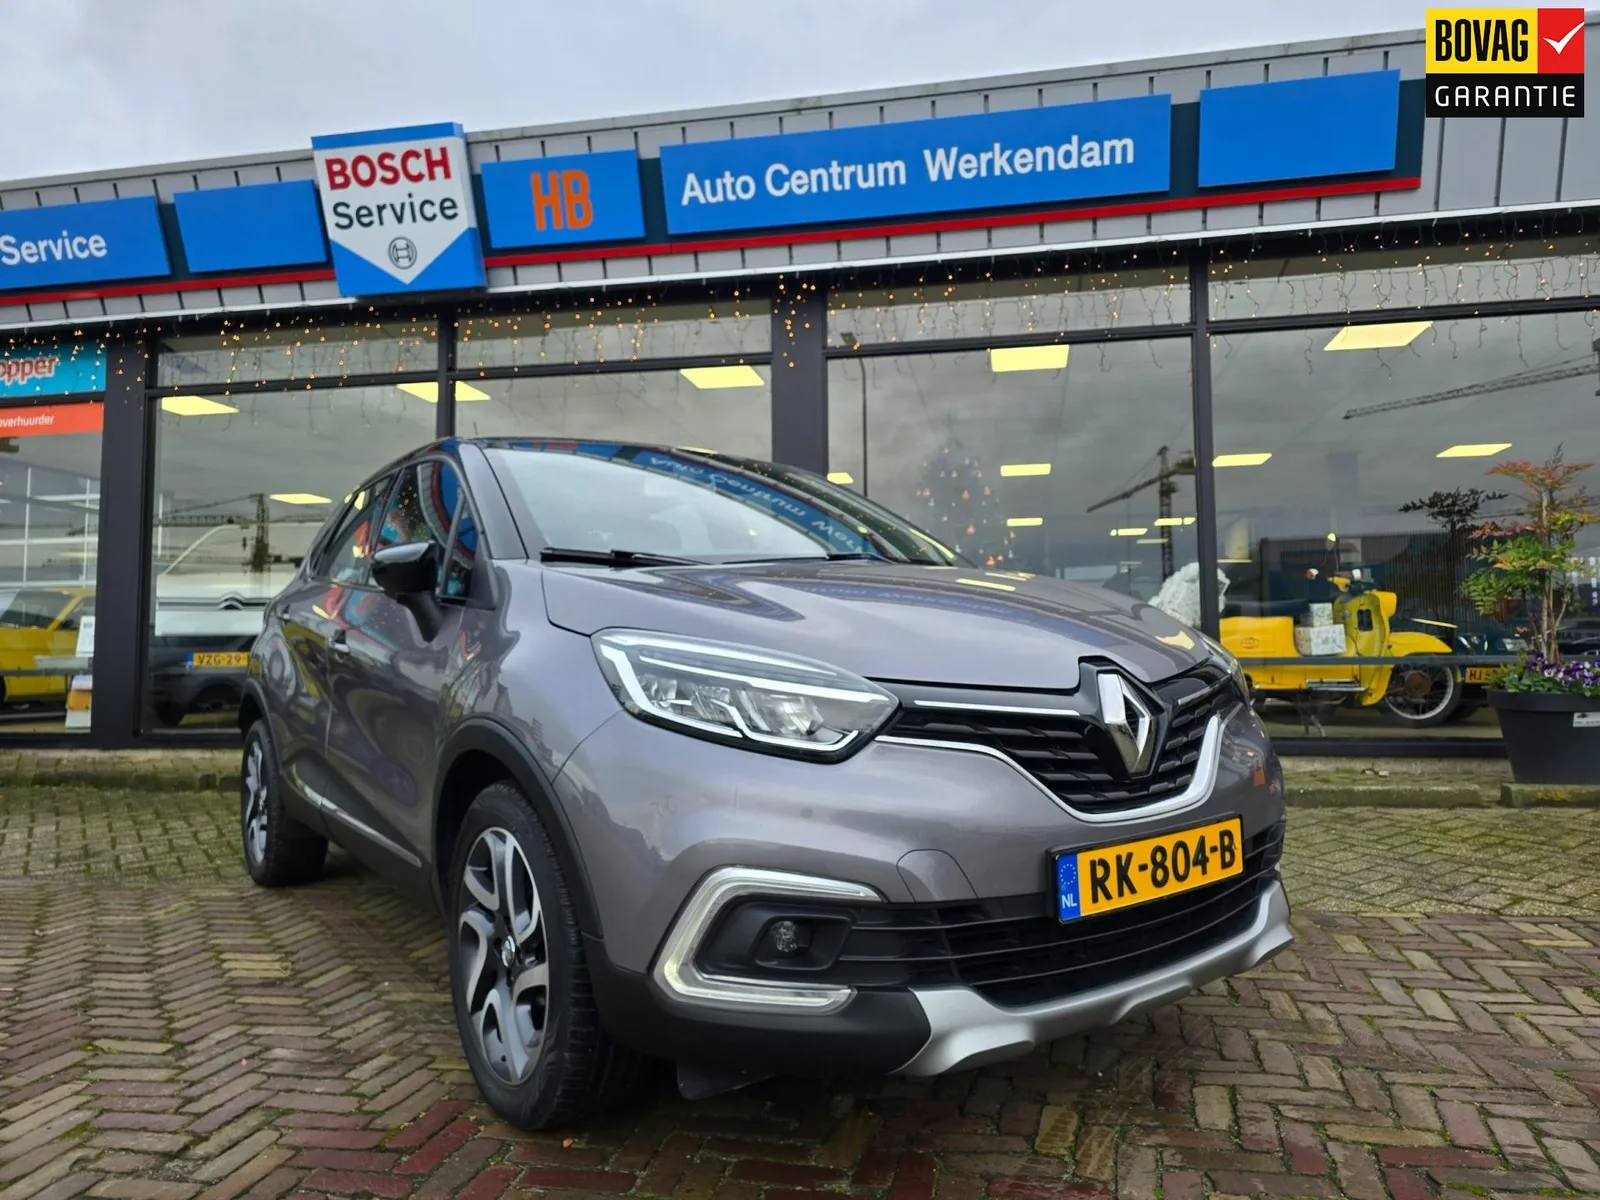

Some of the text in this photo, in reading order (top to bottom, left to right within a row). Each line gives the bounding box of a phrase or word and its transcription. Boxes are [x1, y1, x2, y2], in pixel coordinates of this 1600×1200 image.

[325, 147, 452, 190] BOSCH
[681, 134, 1135, 206] Auto Centrum Werkendam
[333, 192, 459, 230] Service
[530, 169, 594, 231] HB
[0, 229, 108, 266] Service
[1090, 829, 1236, 904] RK-804-B
[1062, 893, 1077, 909] NL
